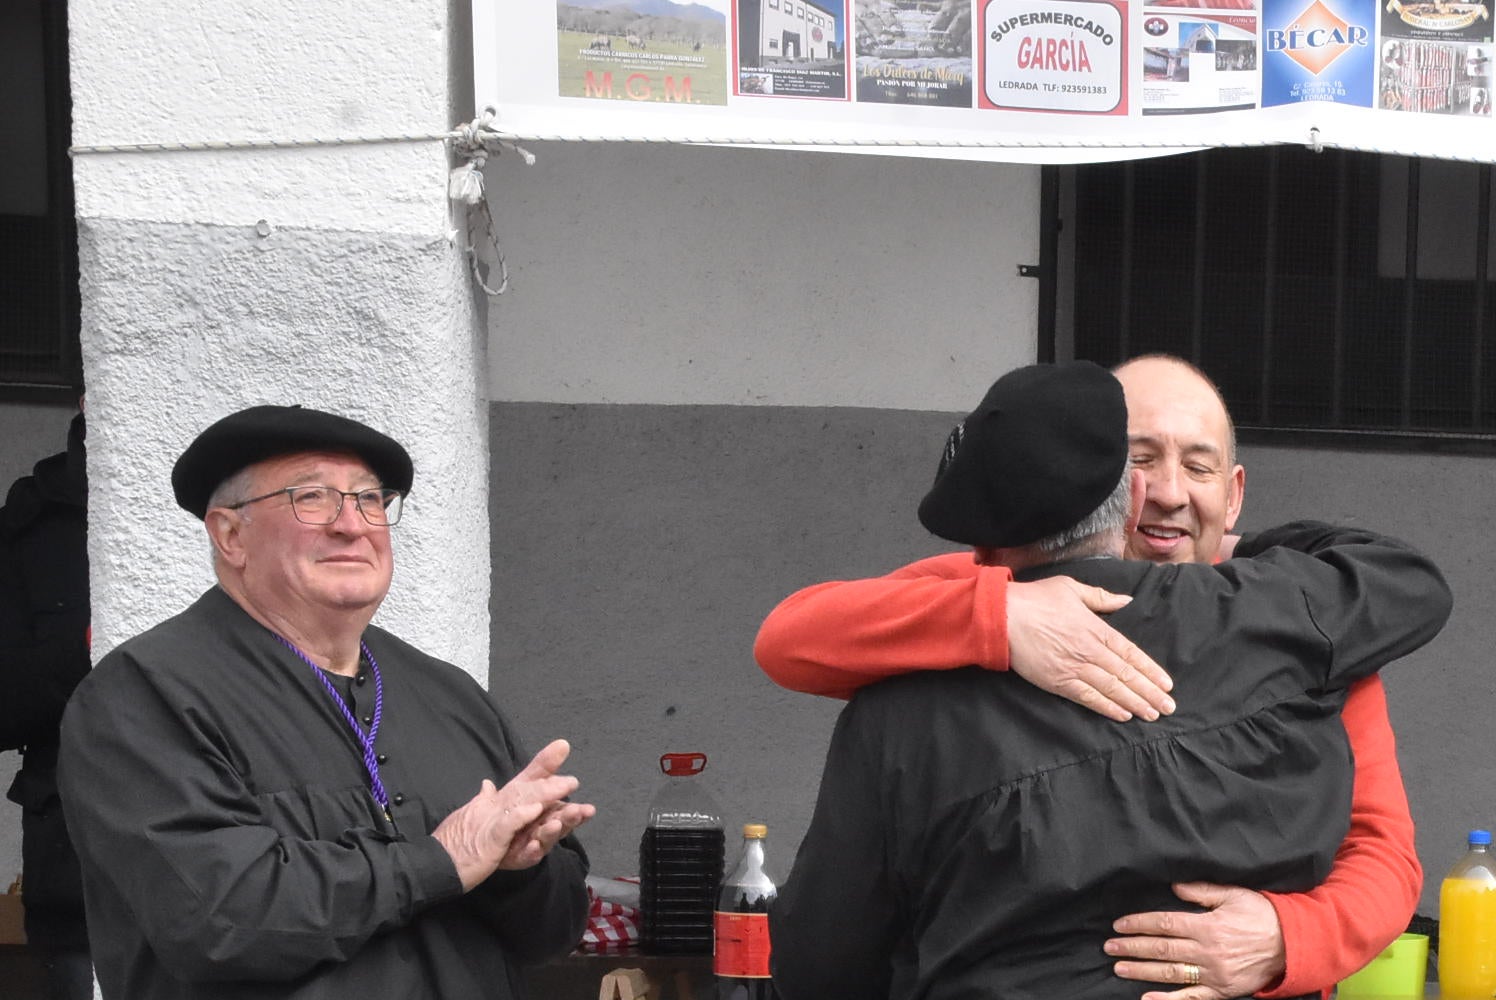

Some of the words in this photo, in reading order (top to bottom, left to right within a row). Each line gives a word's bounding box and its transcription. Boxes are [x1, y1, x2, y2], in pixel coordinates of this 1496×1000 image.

[990, 12, 1114, 46] SUPERMERCADO
[1017, 31, 1092, 73] GARCÍA
[919, 65, 933, 80] de
[901, 80, 916, 88] POR
[916, 81, 948, 89] MEJORAR
[998, 80, 1039, 91] LEDRADA
[1042, 83, 1060, 92] TLF:
[1061, 84, 1108, 95] 923591383
